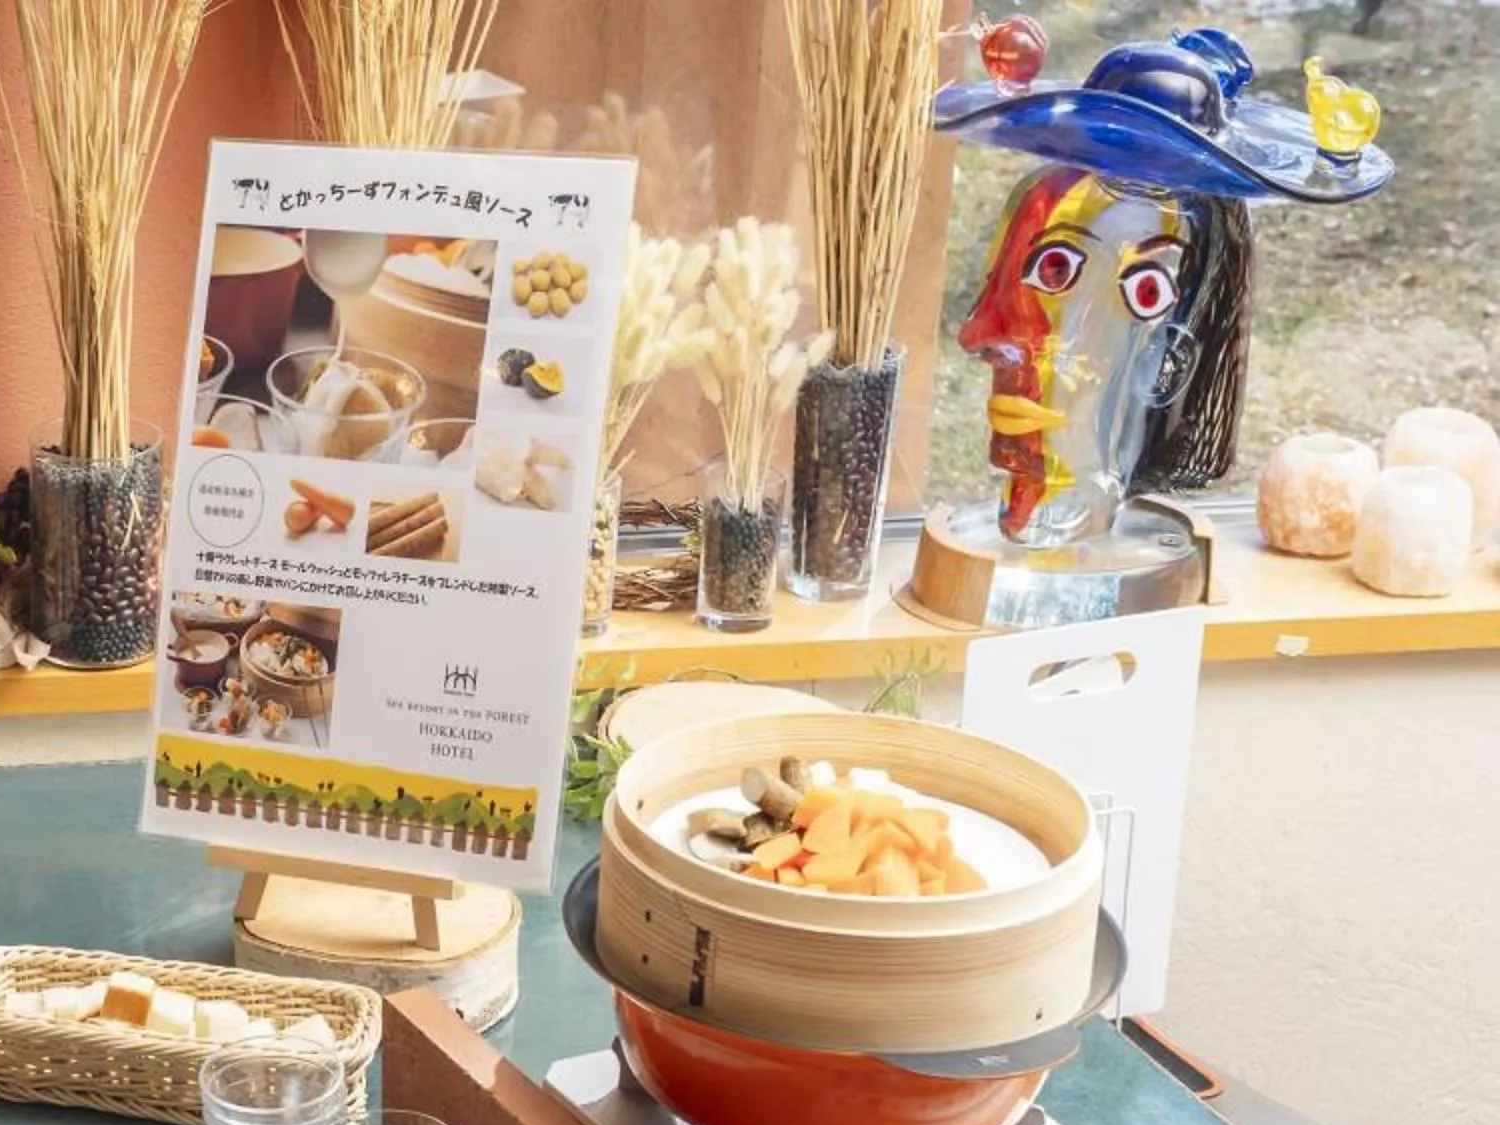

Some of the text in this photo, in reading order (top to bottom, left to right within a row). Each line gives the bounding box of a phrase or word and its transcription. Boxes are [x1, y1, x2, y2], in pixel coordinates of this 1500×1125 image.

[278, 180, 533, 228] とかっちーずフォンデュ風ソース
[485, 709, 530, 725] FOREST
[419, 722, 493, 743] HOKKAIDO
[430, 743, 474, 760] HOTEL
